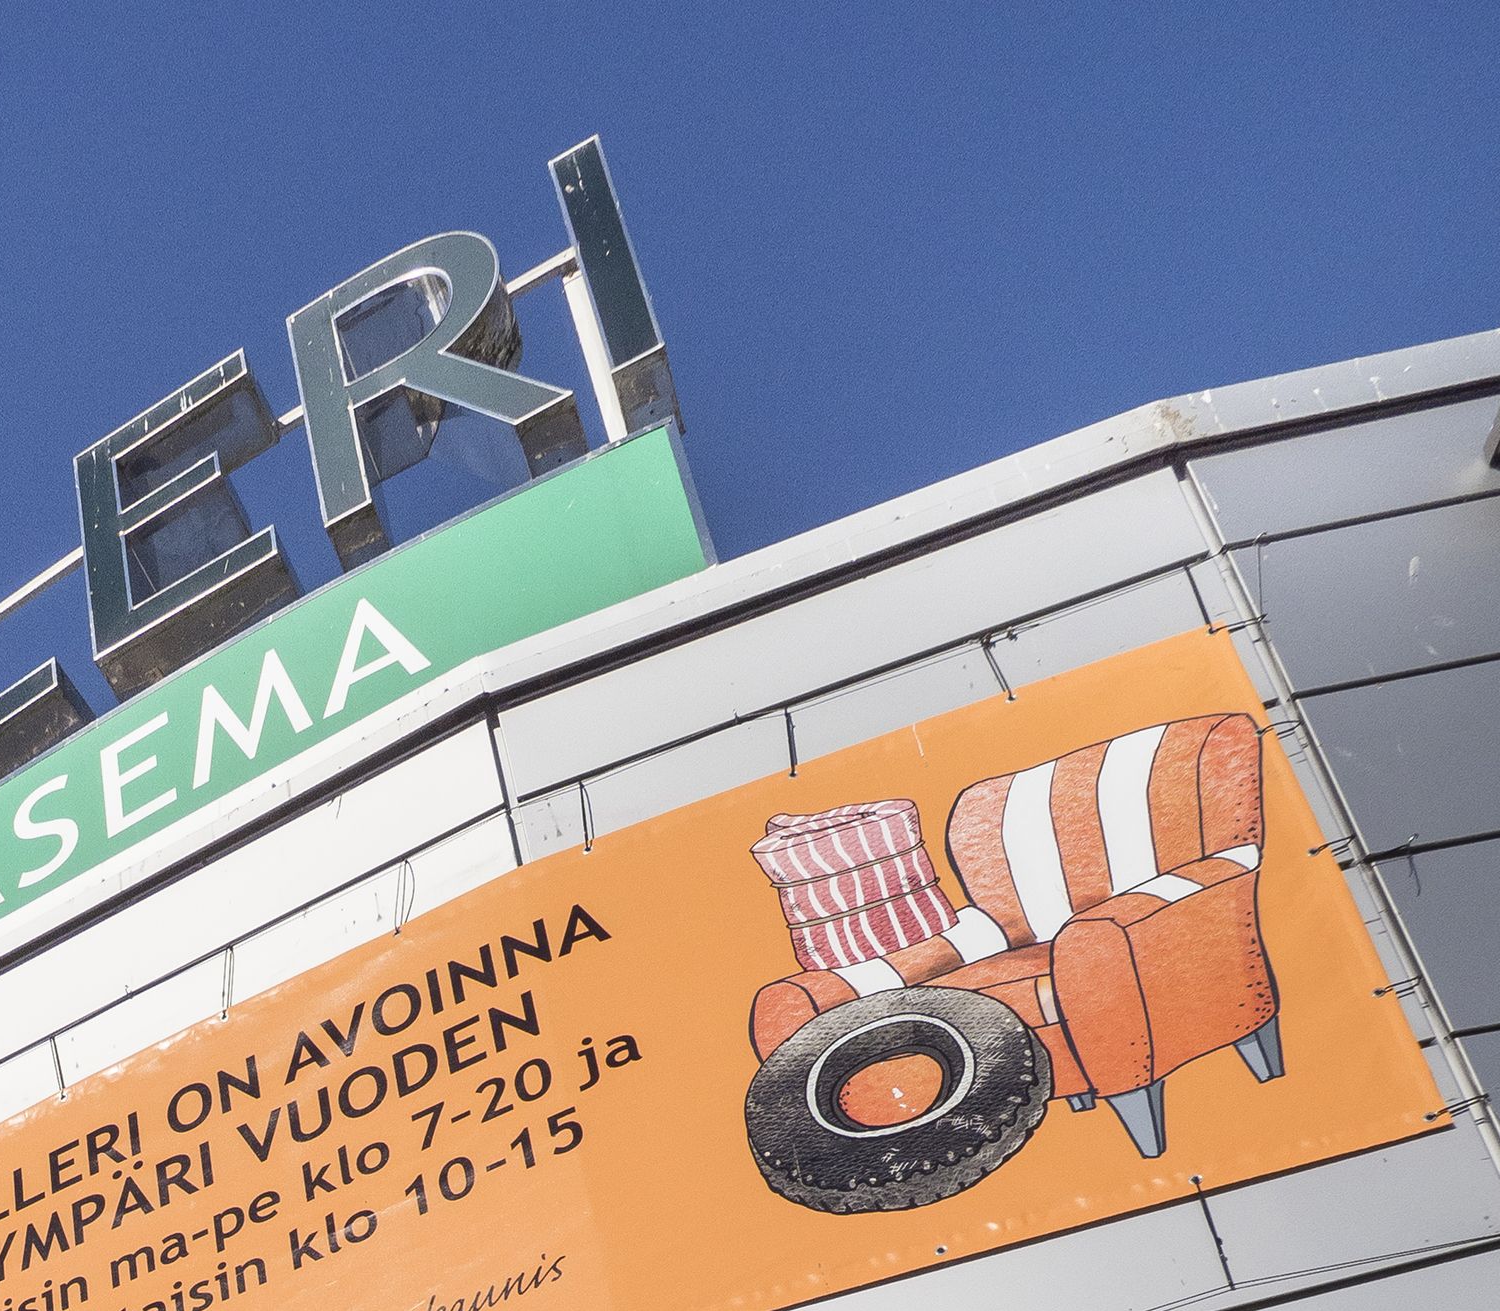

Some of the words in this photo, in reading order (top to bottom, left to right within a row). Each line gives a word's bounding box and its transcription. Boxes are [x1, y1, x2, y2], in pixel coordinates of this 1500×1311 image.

[166, 1055, 261, 1133] ON
[284, 903, 612, 1086] AVOINNA
[236, 989, 541, 1163] VUODEN
[109, 1190, 281, 1289] ma-pe
[301, 1141, 390, 1202] klo
[410, 1058, 553, 1151] 7-20
[577, 1034, 643, 1092] ja
[288, 1209, 378, 1270] klo
[404, 1106, 584, 1216] 10-15
